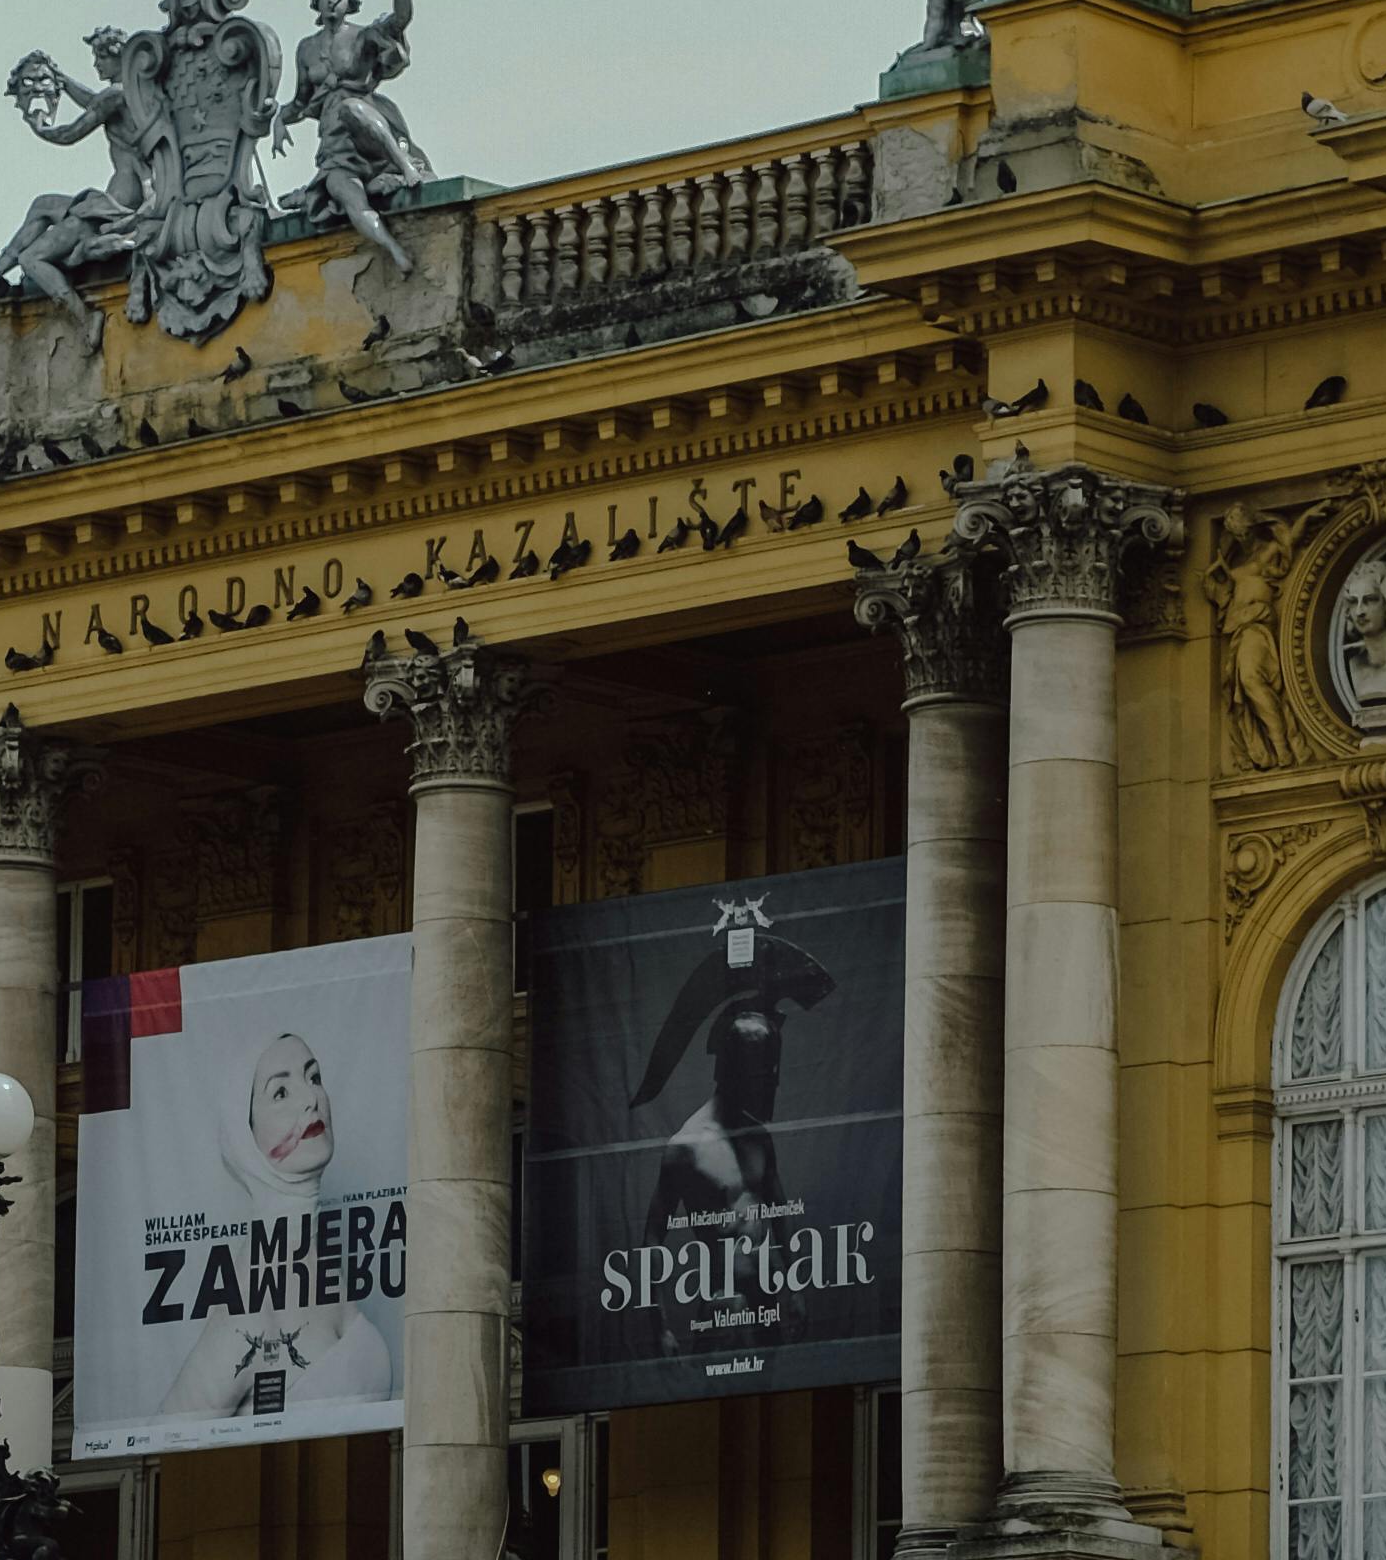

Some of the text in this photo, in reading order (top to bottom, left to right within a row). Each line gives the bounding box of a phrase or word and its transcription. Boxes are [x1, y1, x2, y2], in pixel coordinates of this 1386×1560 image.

[42, 558, 343, 651] NARODNO
[425, 469, 802, 580] KAZALIŠTE
[145, 1213, 206, 1232] WILLIAM
[145, 1222, 248, 1246] SHAKESPEARE
[251, 1201, 407, 1266] MJERA
[714, 1307, 756, 1327] Valentin
[758, 1302, 781, 1327] Egel
[705, 1355, 765, 1377] www.hnk.hr
